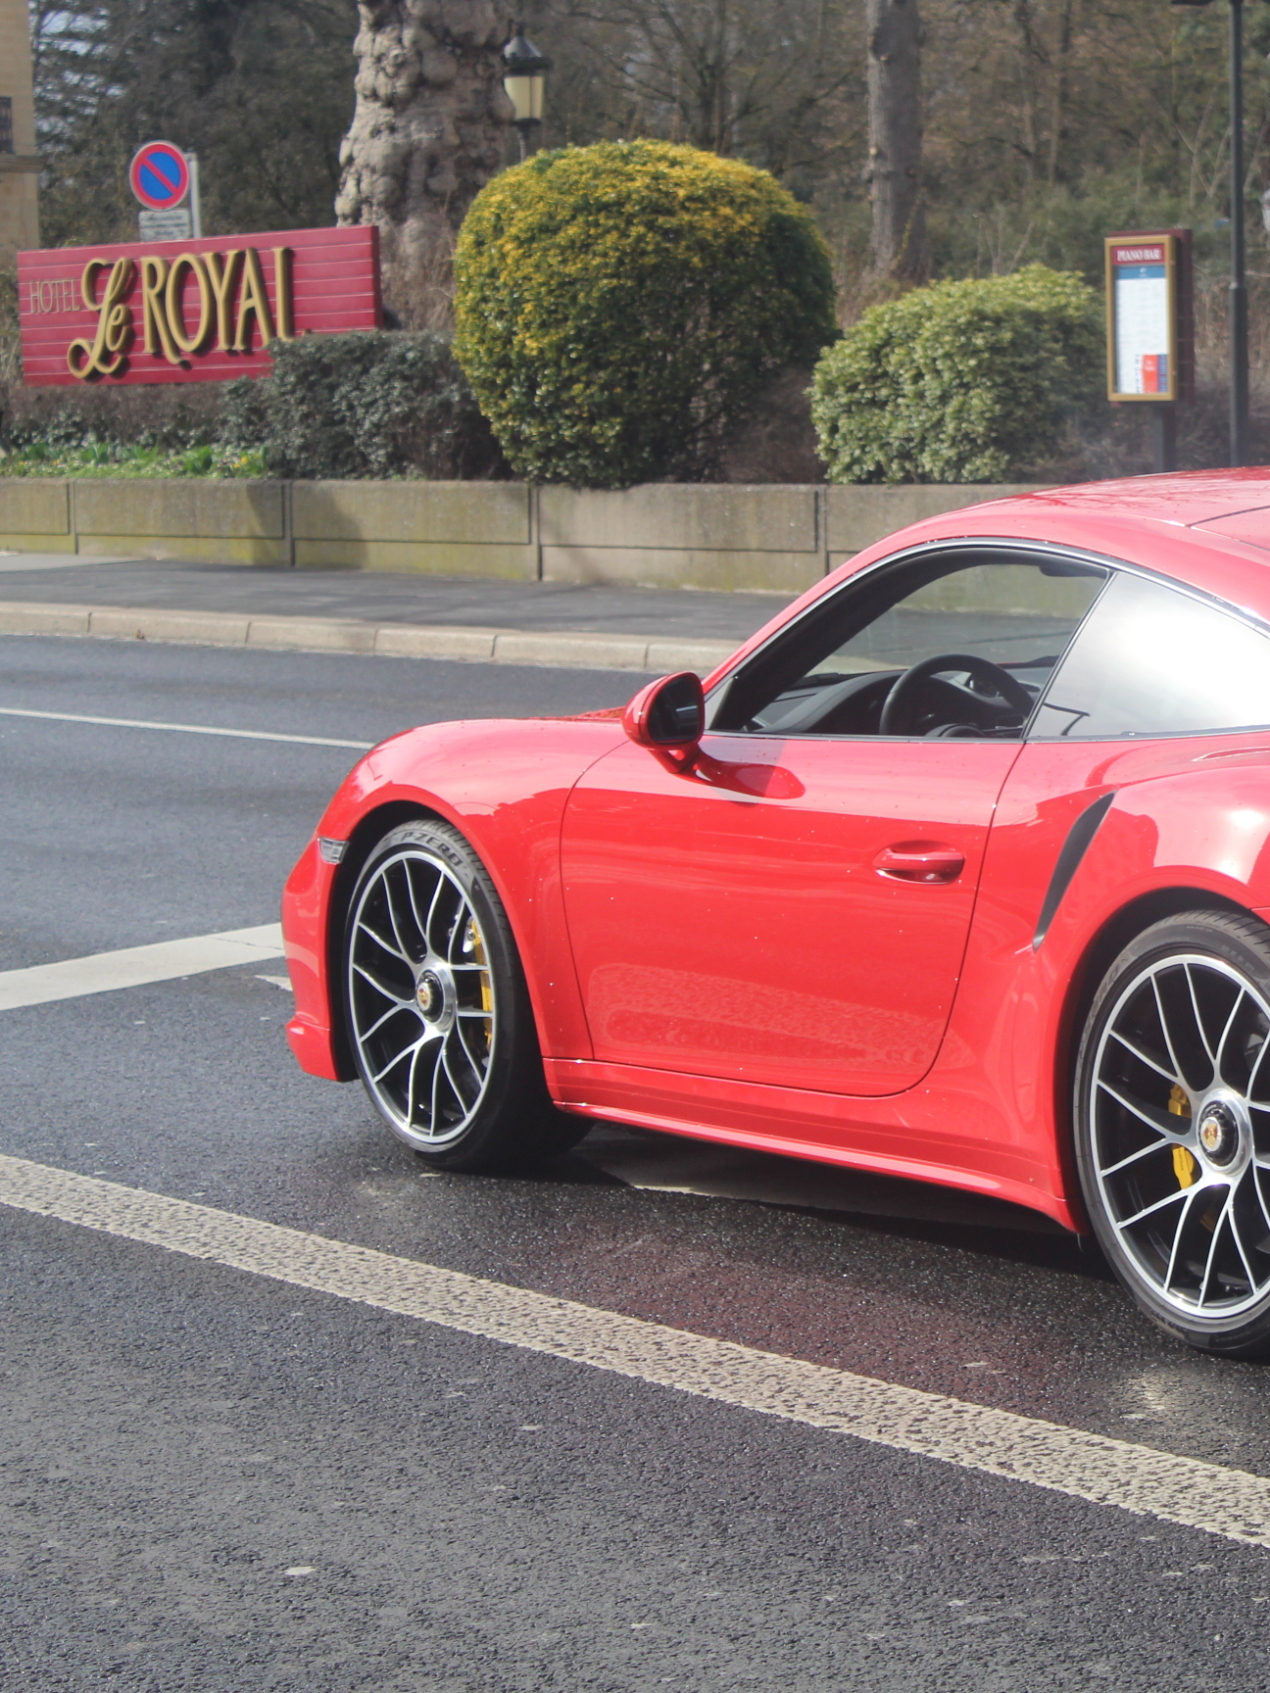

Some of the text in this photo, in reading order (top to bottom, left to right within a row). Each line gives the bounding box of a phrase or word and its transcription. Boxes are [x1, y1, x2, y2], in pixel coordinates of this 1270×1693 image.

[1116, 248, 1161, 262] PIANO BAR
[29, 246, 306, 379] HOTEL Le ROYAL
